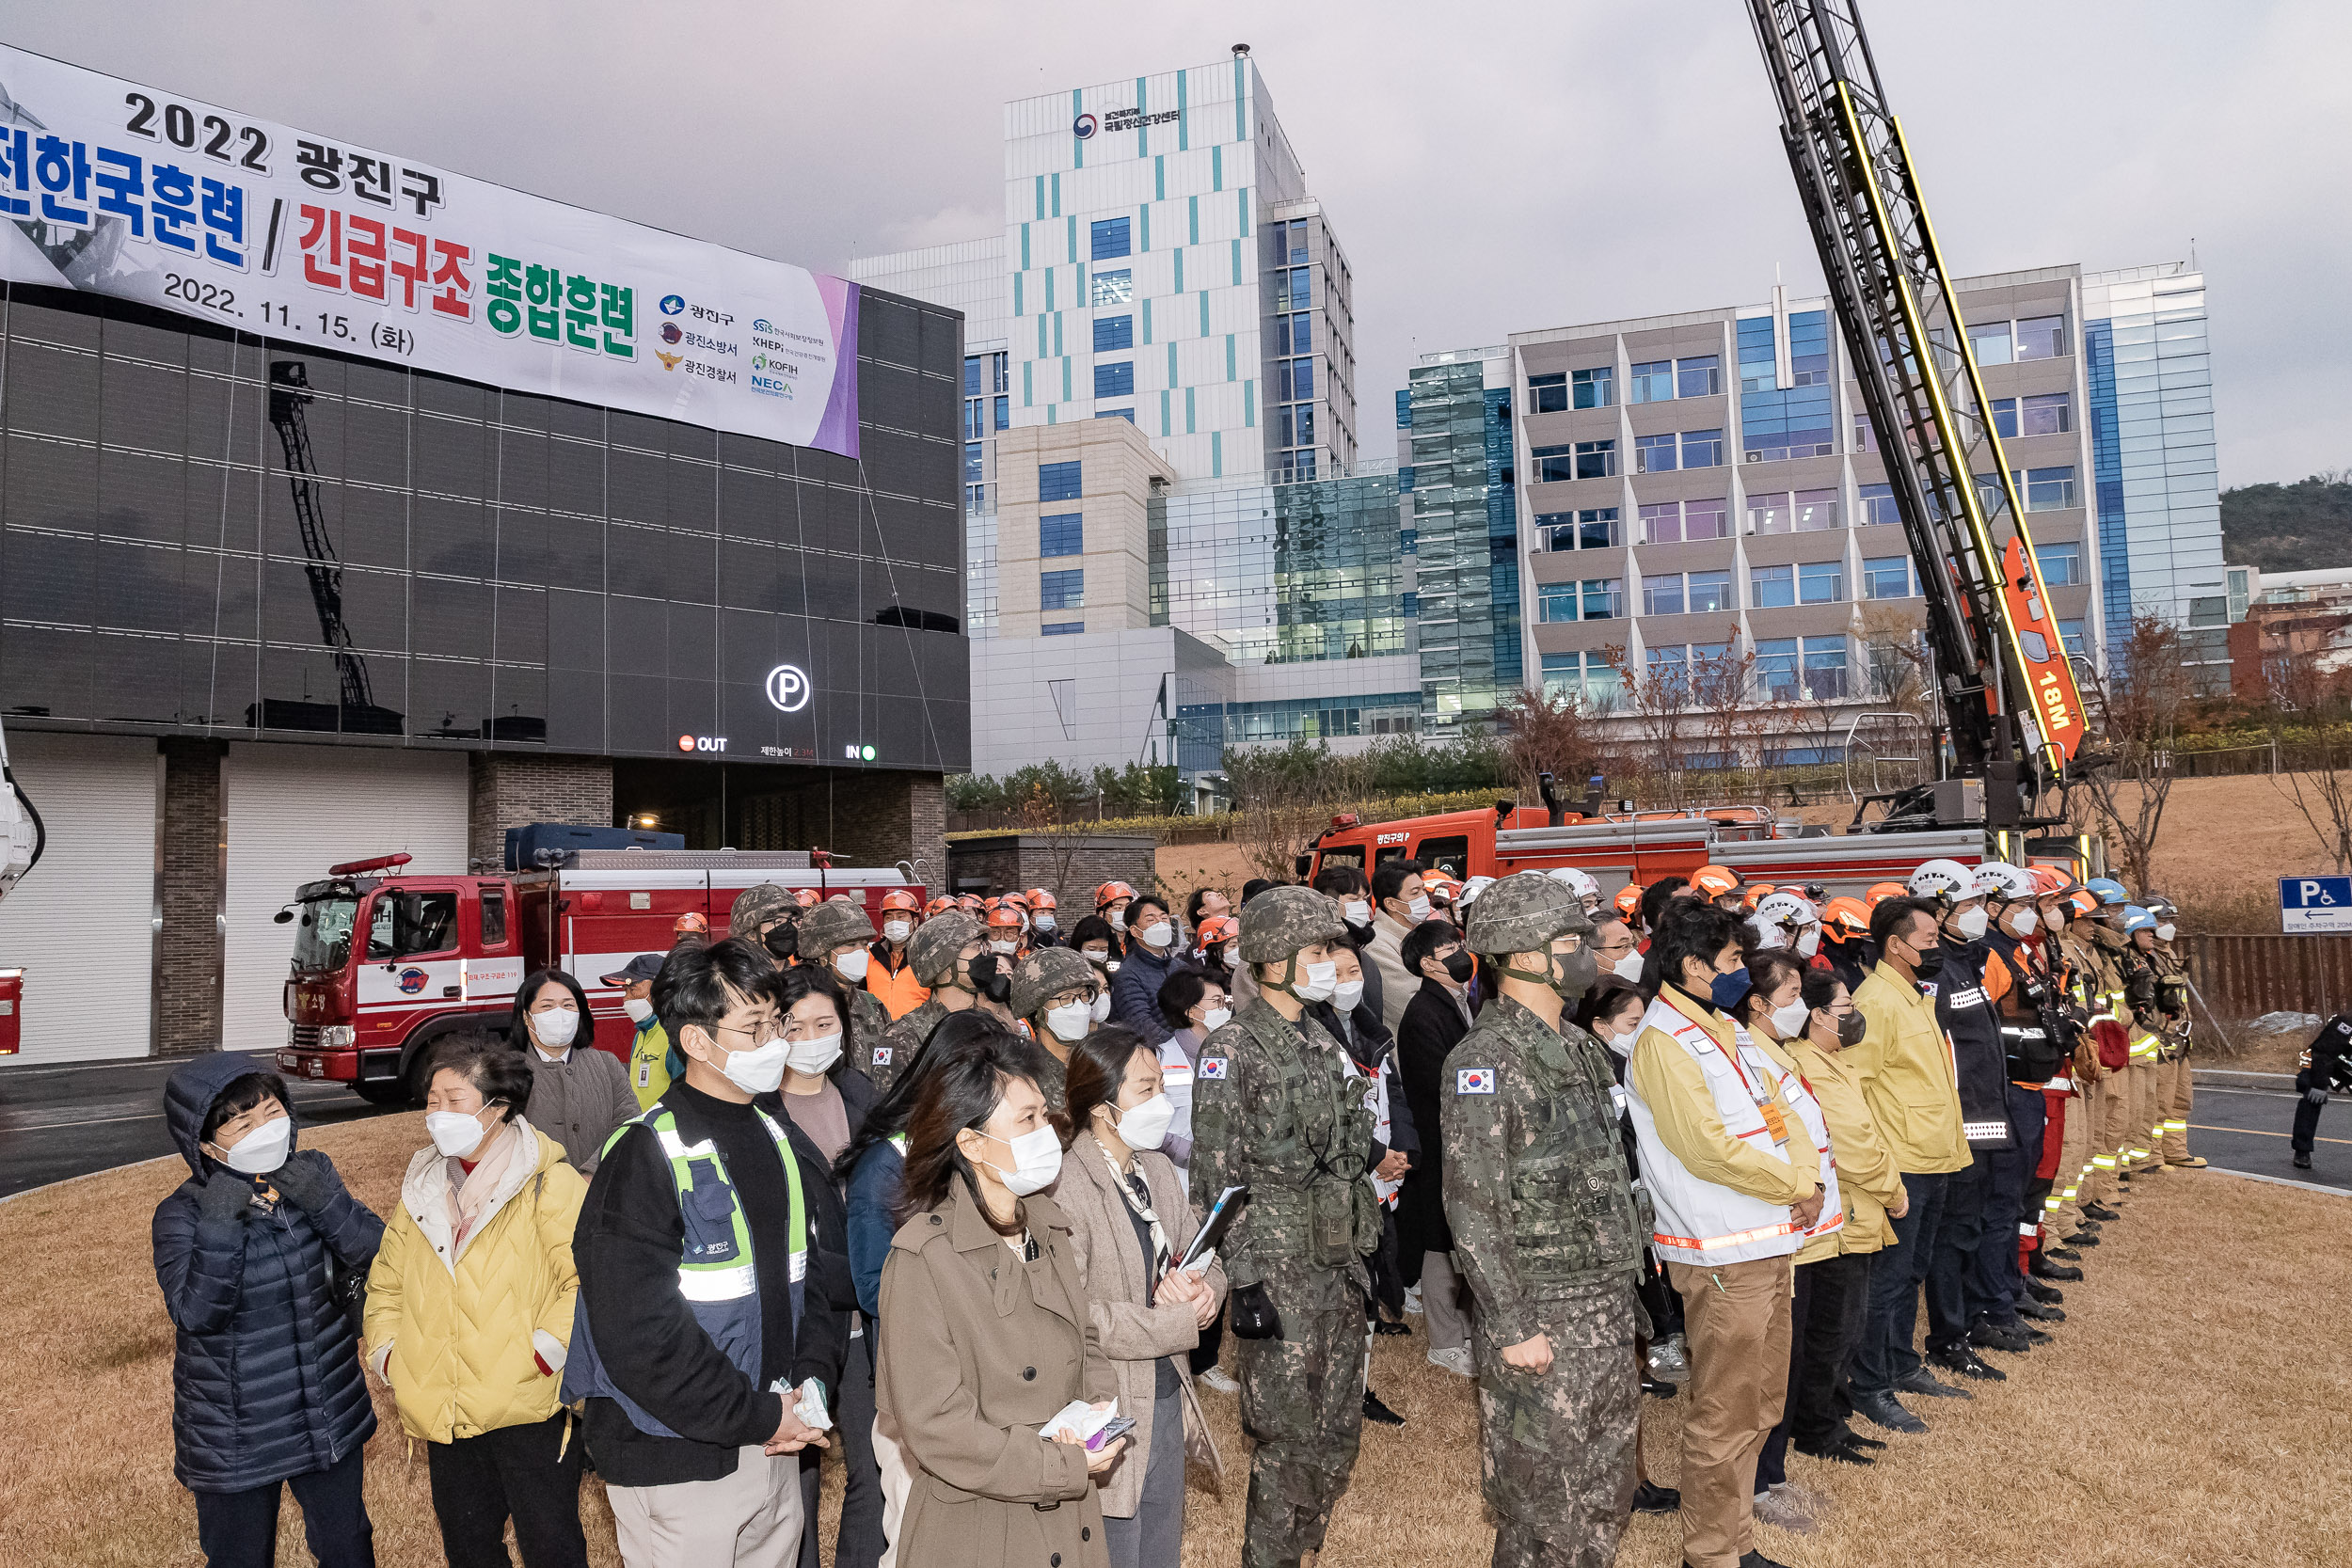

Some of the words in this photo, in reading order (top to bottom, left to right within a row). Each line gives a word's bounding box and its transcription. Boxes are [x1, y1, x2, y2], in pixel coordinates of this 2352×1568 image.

[1104, 106, 1141, 121] 보건복지부
[1104, 109, 1181, 133] 국립정신건강센터
[125, 92, 267, 173] 2022
[295, 139, 441, 216] 광진구
[298, 203, 471, 319] 긴급구조
[485, 252, 634, 358] 종합훈련
[164, 273, 244, 318] 2022.
[260, 301, 302, 331] 11.
[318, 312, 357, 342] 15.
[371, 322, 415, 356] (화)
[690, 304, 735, 325] 광진구
[685, 332, 738, 356] 광진소방서
[753, 336, 784, 353] KHEPi
[685, 360, 737, 384] 광진경찰서
[769, 358, 799, 375] KOFIH
[751, 374, 793, 394] NECA
[778, 672, 801, 705] P
[2039, 670, 2071, 731] 18M
[697, 736, 728, 752] OUT
[760, 746, 792, 757] 제한높이
[845, 745, 860, 759] IN
[2299, 880, 2321, 907] P
[311, 993, 326, 1012] 소방
